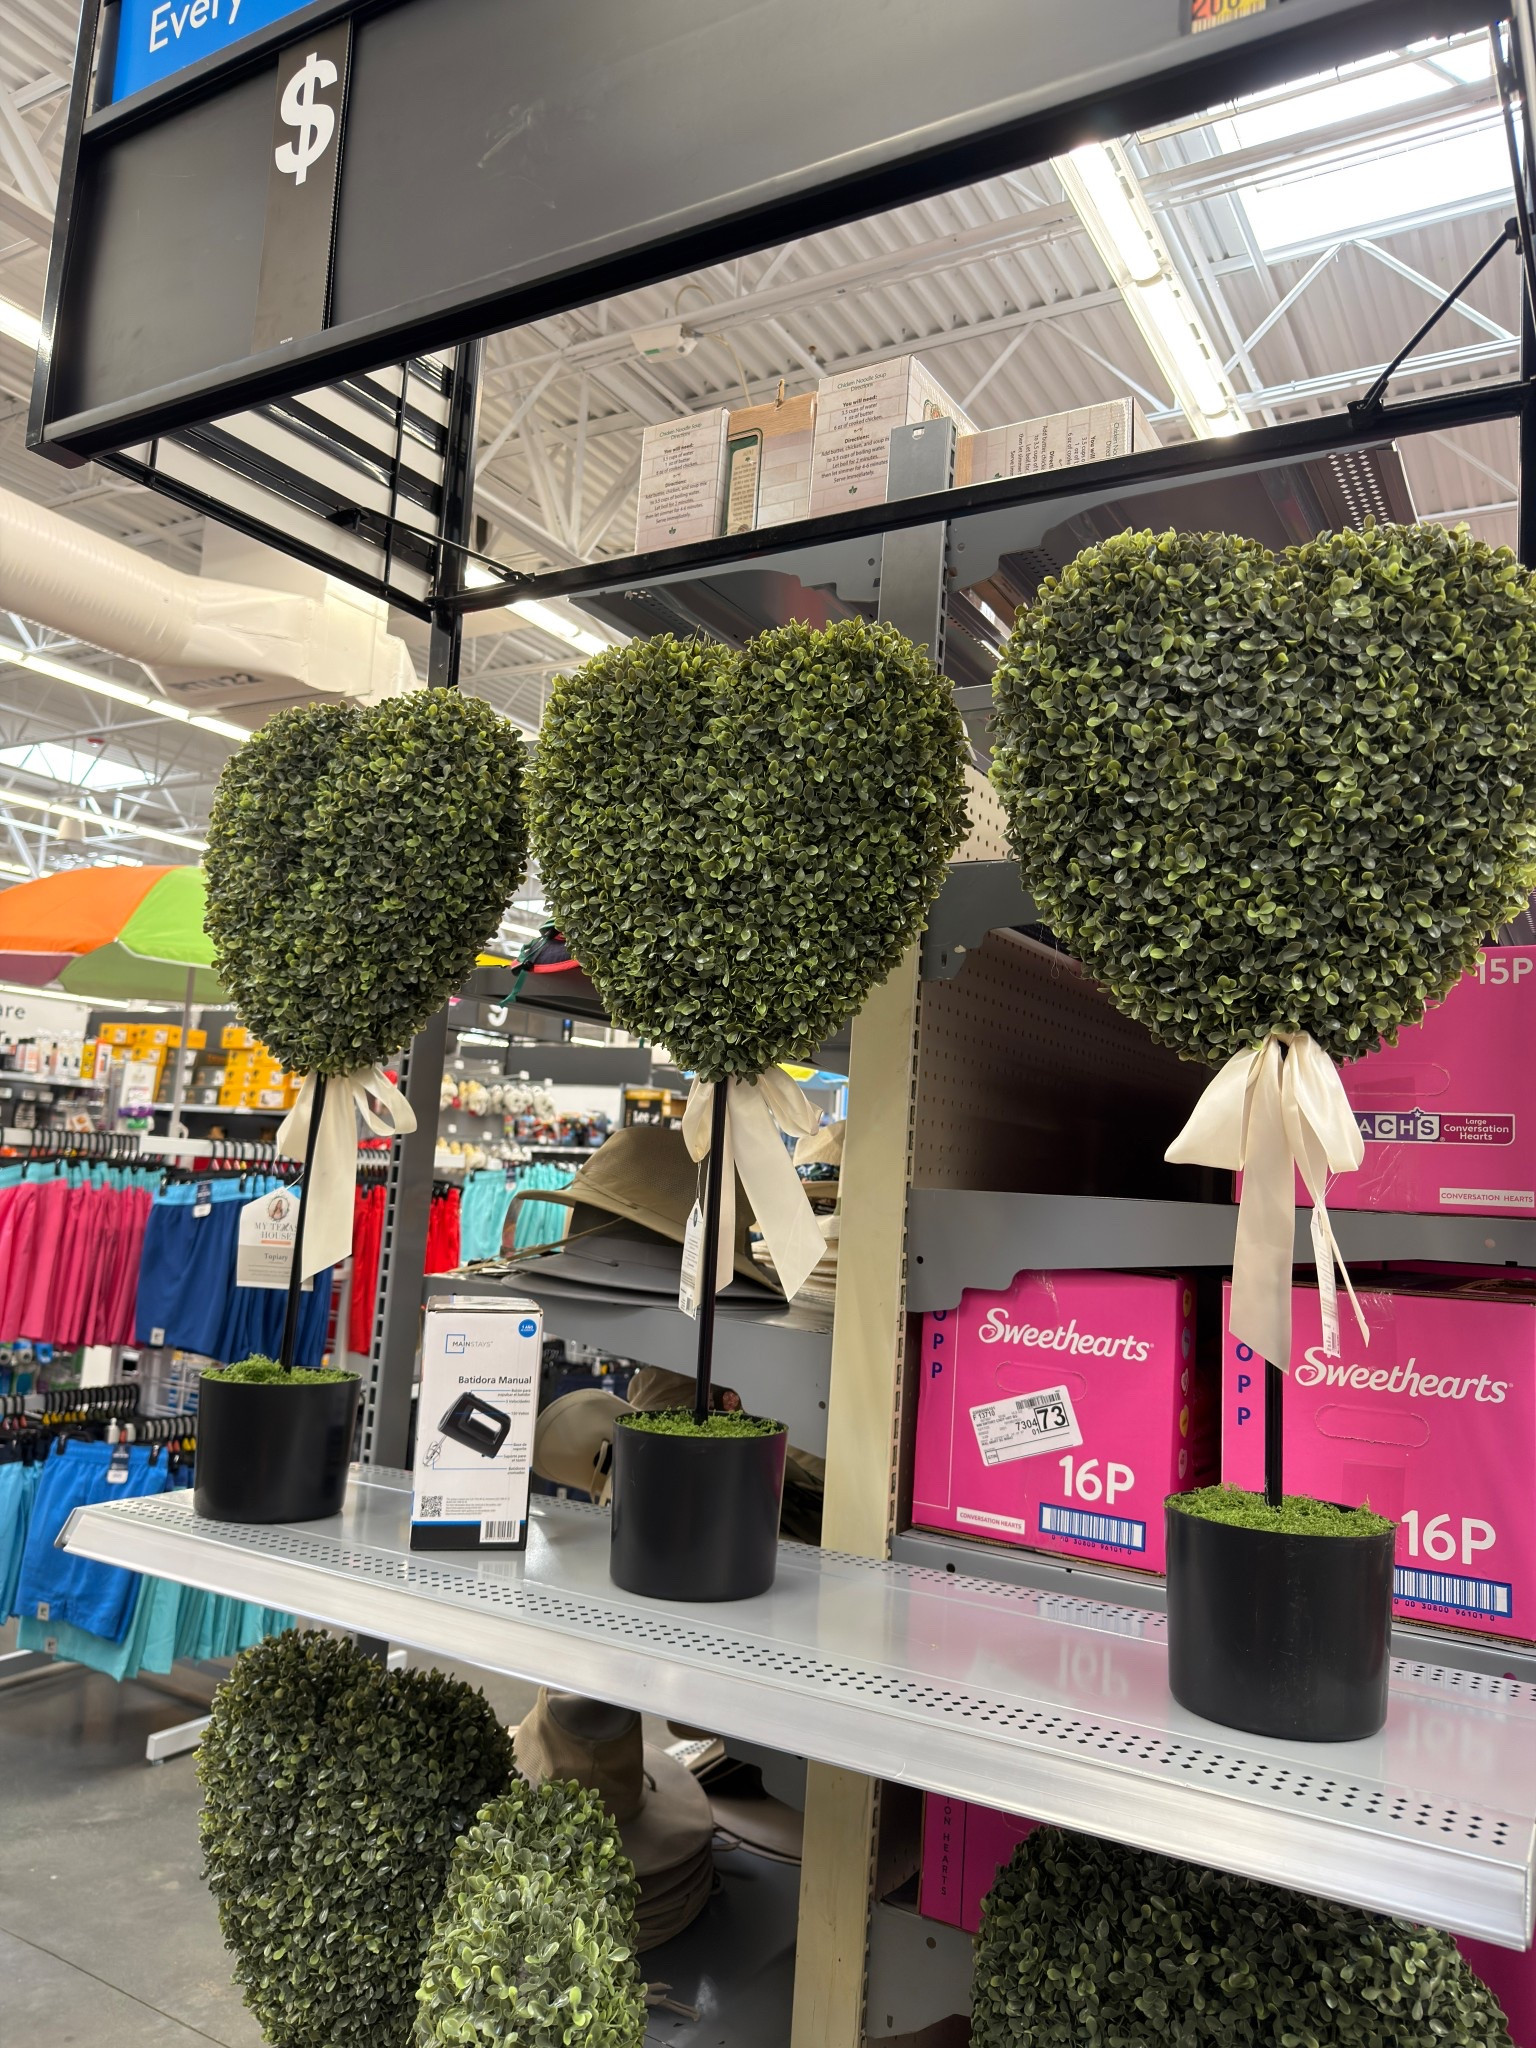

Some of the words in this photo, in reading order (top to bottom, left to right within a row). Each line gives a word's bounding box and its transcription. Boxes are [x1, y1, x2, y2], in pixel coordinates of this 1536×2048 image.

[275, 52, 337, 185] $
[874, 372, 887, 380] Soup
[860, 410, 874, 418] butter
[848, 418, 864, 426] cooked
[845, 435, 870, 444] Directions:
[1443, 1124, 1509, 1133] Conversation
[1459, 1132, 1493, 1141] Hearts
[1441, 1192, 1500, 1201] CONVERSATION
[1503, 1195, 1533, 1203] HEARTS
[255, 1222, 268, 1230] MY
[264, 1252, 288, 1262] Topiary
[978, 1307, 1150, 1362] Sweethearts
[458, 1375, 496, 1384] Batidora
[498, 1375, 532, 1384] Manual
[1294, 1346, 1508, 1404] Sweethearts
[1015, 1418, 1037, 1430] 7304
[1037, 1406, 1065, 1430] 73
[1059, 1455, 1135, 1505] 16P
[960, 1512, 1000, 1525] CONVERSATION
[1001, 1520, 1022, 1529] HEARTS
[1401, 1510, 1496, 1565] 16P
[1100, 1543, 1122, 1553] 96101
[1405, 1600, 1416, 1608] 00
[1421, 1602, 1449, 1614] 30800
[1455, 1608, 1483, 1619] 96101
[1489, 1614, 1495, 1622] 0
[941, 1833, 950, 1896] HEARTS
